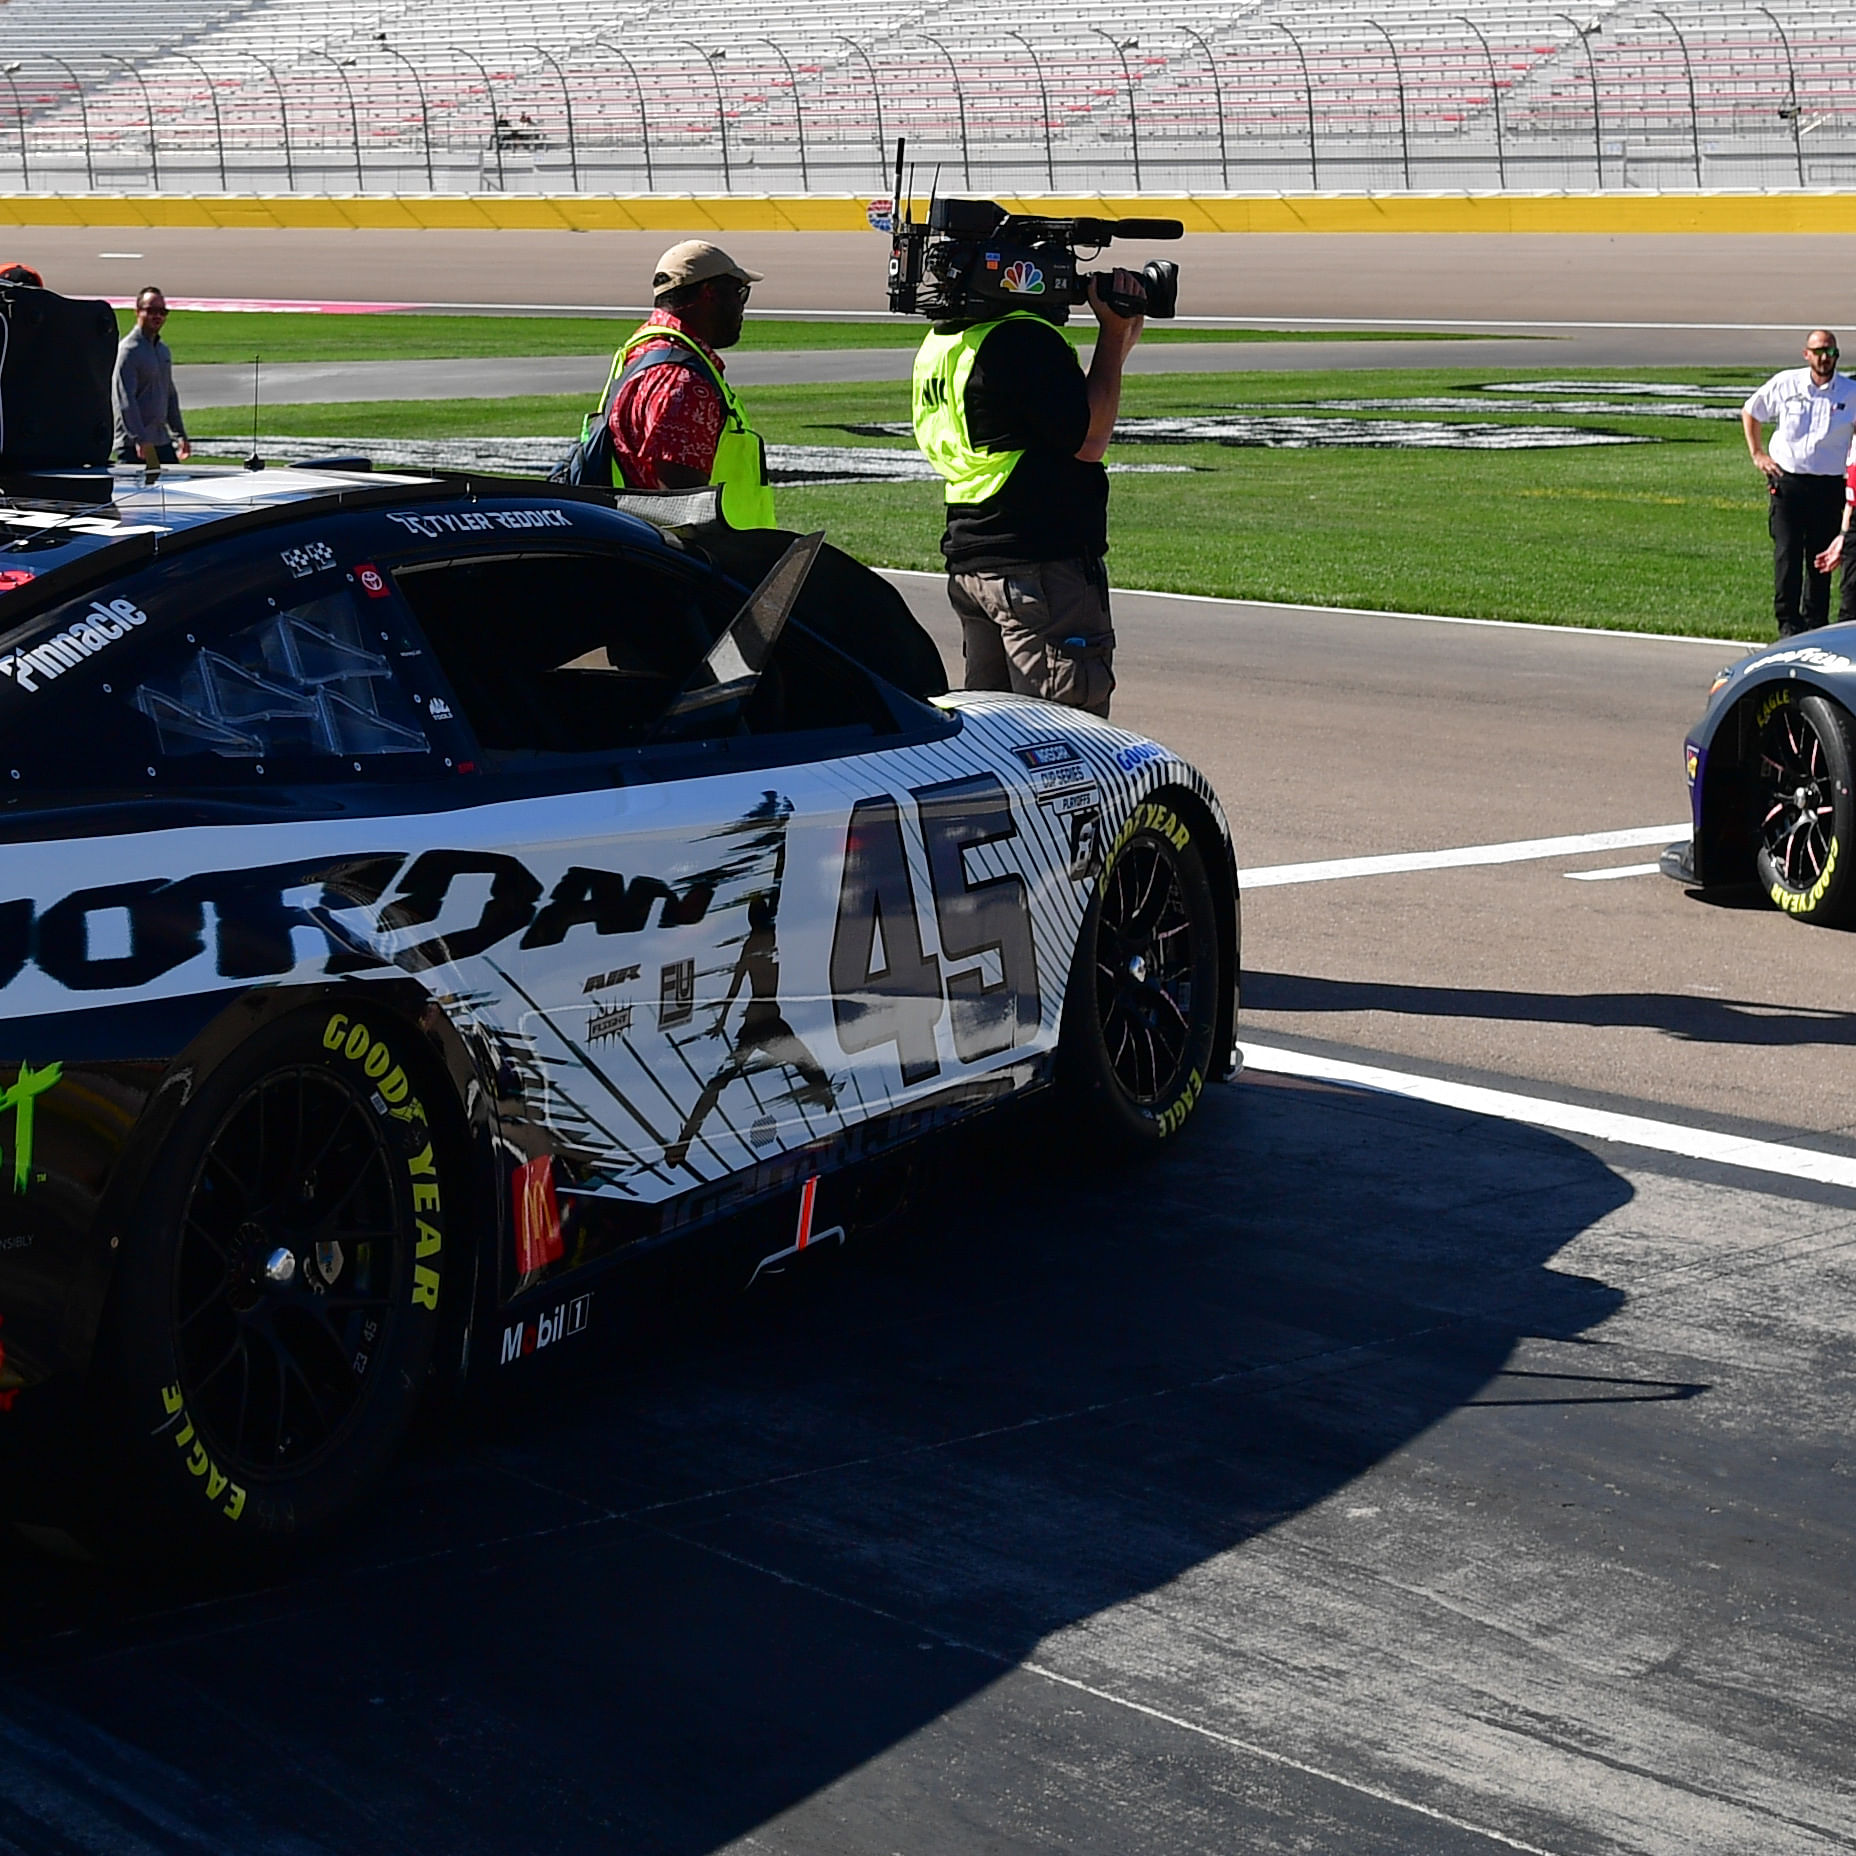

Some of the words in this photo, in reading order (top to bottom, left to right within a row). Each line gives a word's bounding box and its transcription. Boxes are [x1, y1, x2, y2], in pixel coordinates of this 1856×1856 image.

[426, 511, 496, 533] TYLER
[487, 509, 574, 530] REDDICK
[1771, 835, 1840, 913] GOODYEAR
[829, 771, 1042, 1087] 45
[1158, 1066, 1204, 1138] EAGLE
[322, 1012, 442, 1312] GOODYEAR
[500, 1304, 566, 1365] Mobil
[161, 1380, 248, 1521] EAGLE
